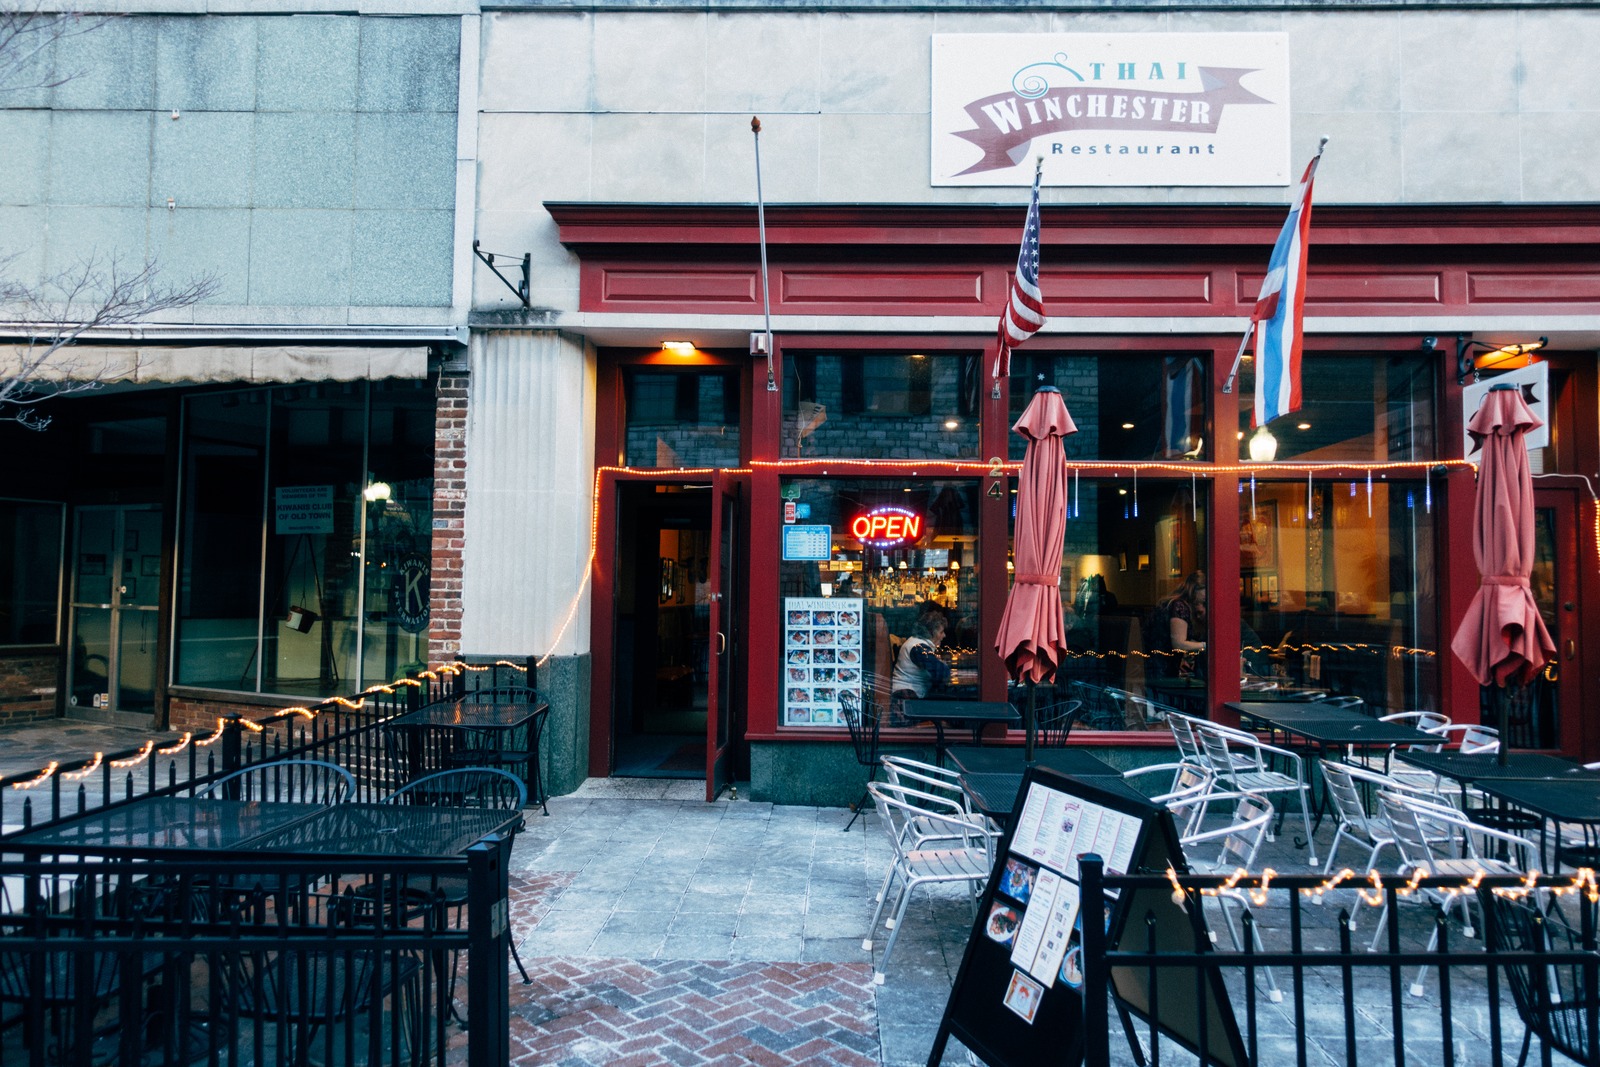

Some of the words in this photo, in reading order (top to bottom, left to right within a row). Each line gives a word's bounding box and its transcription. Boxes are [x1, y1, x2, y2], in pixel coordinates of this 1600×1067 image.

[1089, 62, 1187, 80] THAI
[981, 94, 1210, 135] WINCHESTER
[1052, 143, 1215, 155] Restaurant
[852, 516, 920, 538] OPEN
[400, 560, 430, 576] KIWANIS
